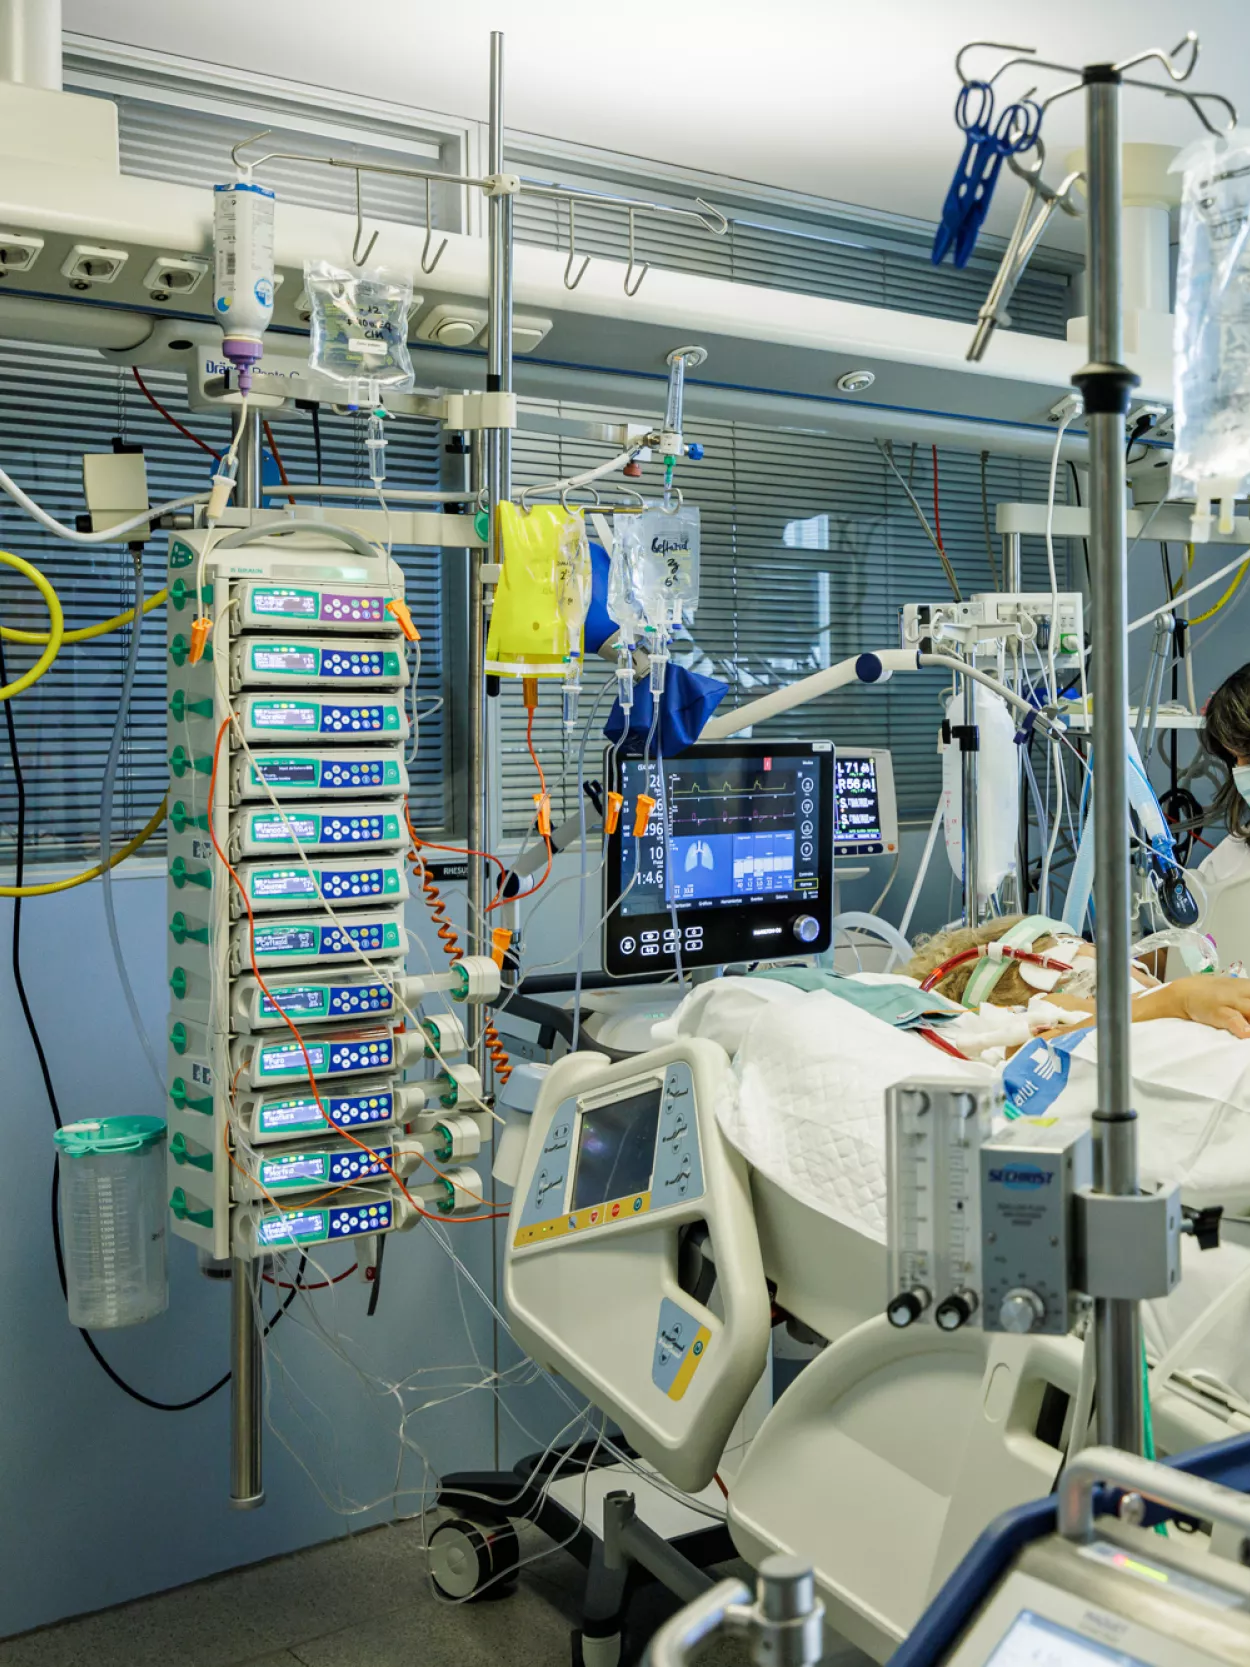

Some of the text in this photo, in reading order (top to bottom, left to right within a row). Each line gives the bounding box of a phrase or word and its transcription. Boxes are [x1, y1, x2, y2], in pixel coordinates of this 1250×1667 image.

[845, 762, 859, 773] 71
[846, 778, 861, 789] 56
[650, 847, 663, 859] 10
[637, 871, 663, 885] 1:4.6
[1012, 1079, 1039, 1107] alut
[988, 1168, 1055, 1185] SECHRIST
